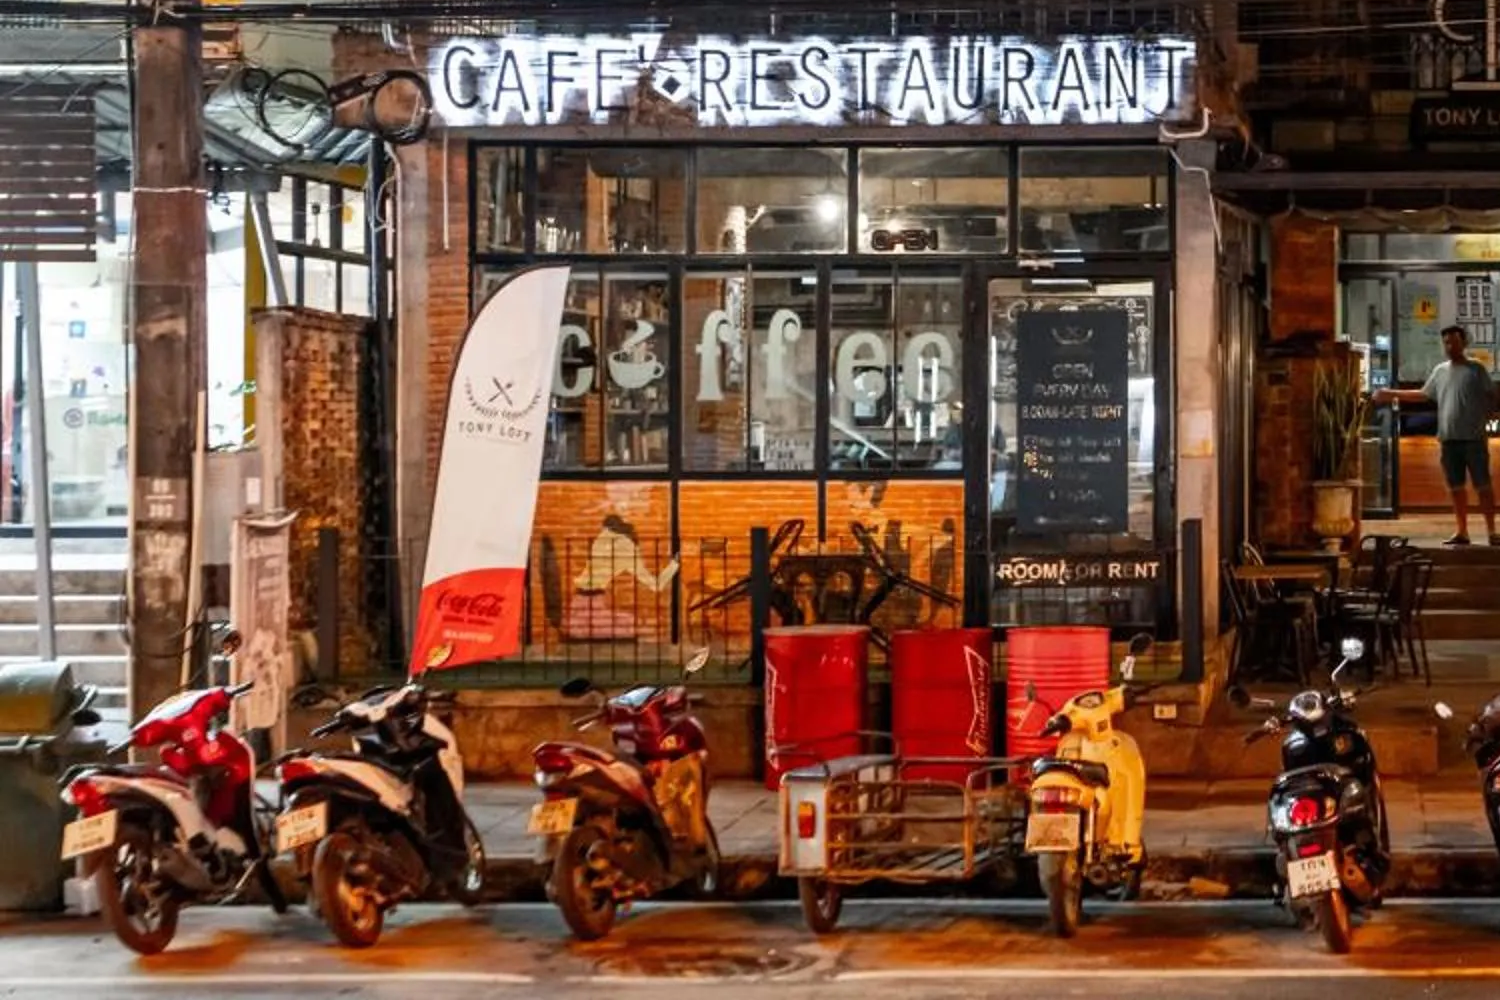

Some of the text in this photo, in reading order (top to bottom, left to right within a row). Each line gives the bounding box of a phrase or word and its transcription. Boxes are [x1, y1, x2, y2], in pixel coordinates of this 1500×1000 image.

[699, 45, 1188, 112] RESTAURANT
[1423, 106, 1482, 127] TONY
[1107, 561, 1160, 579] RENT
